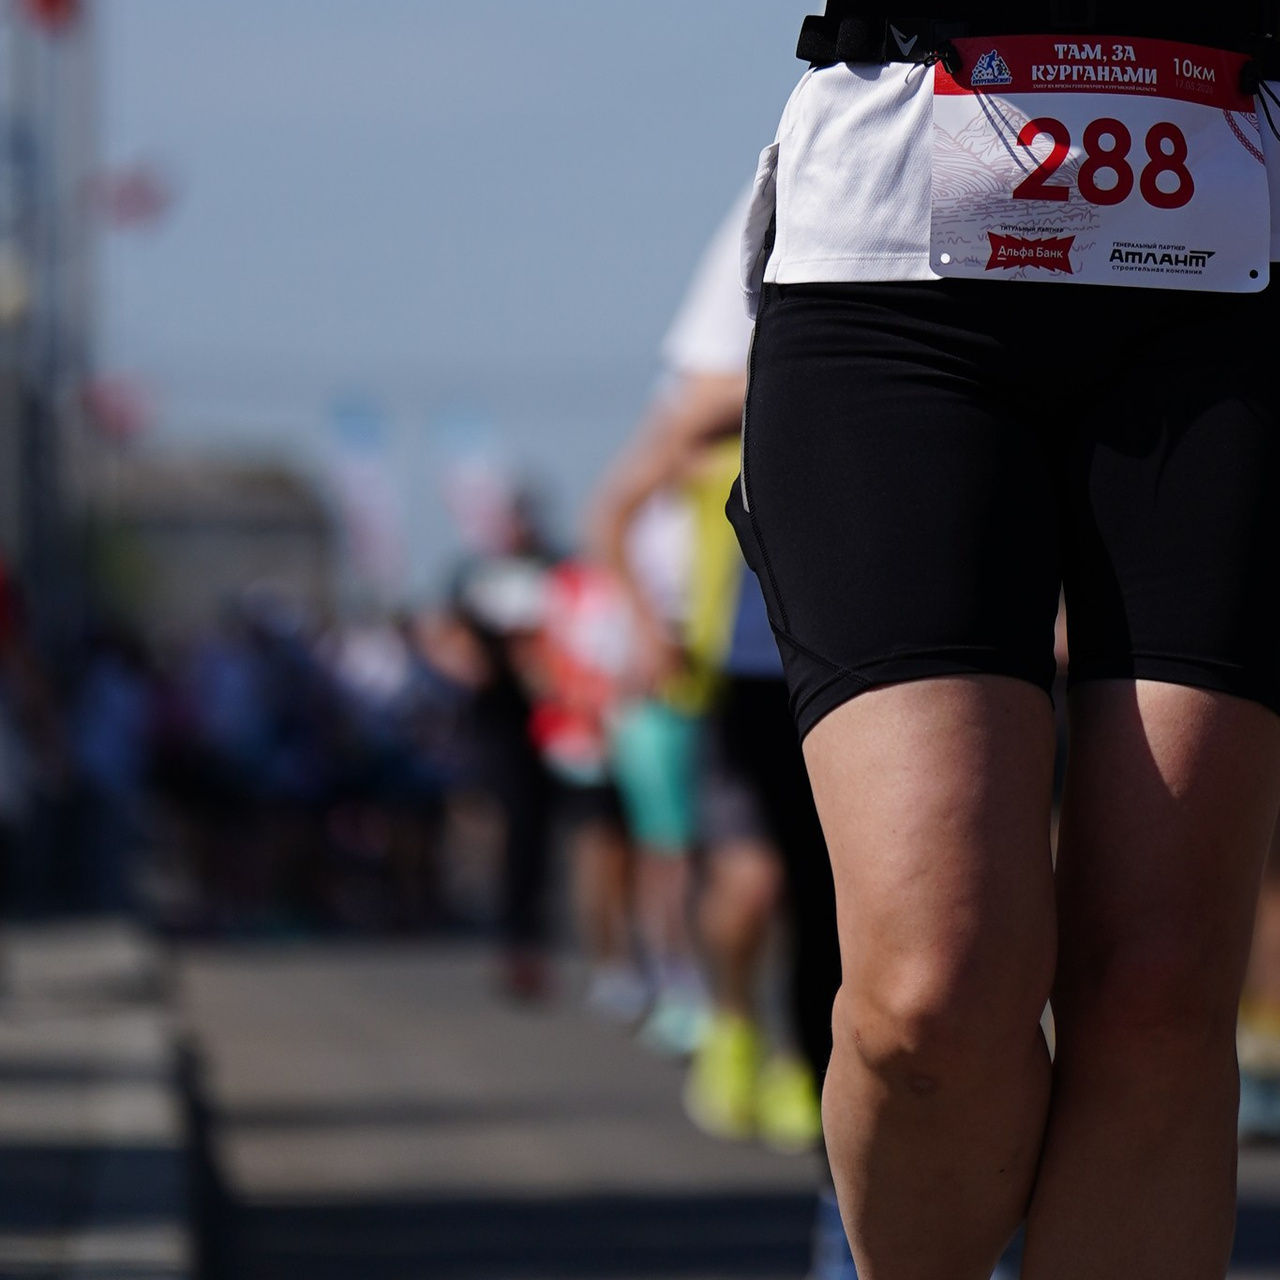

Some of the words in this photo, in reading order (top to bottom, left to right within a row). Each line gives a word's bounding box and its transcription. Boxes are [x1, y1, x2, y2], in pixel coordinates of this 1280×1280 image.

[1054, 43, 1108, 63] ТАМ,
[1111, 43, 1137, 62] ЗА
[1031, 64, 1158, 85] КУРГАНАМИ
[1012, 117, 1195, 209] 288
[997, 245, 1034, 260] Альфа
[1036, 247, 1063, 259] Банк
[1112, 241, 1157, 250] ГЕНЕРАЛЬНЫЙ
[1112, 264, 1165, 273] строительная
[1166, 267, 1203, 275] компания
